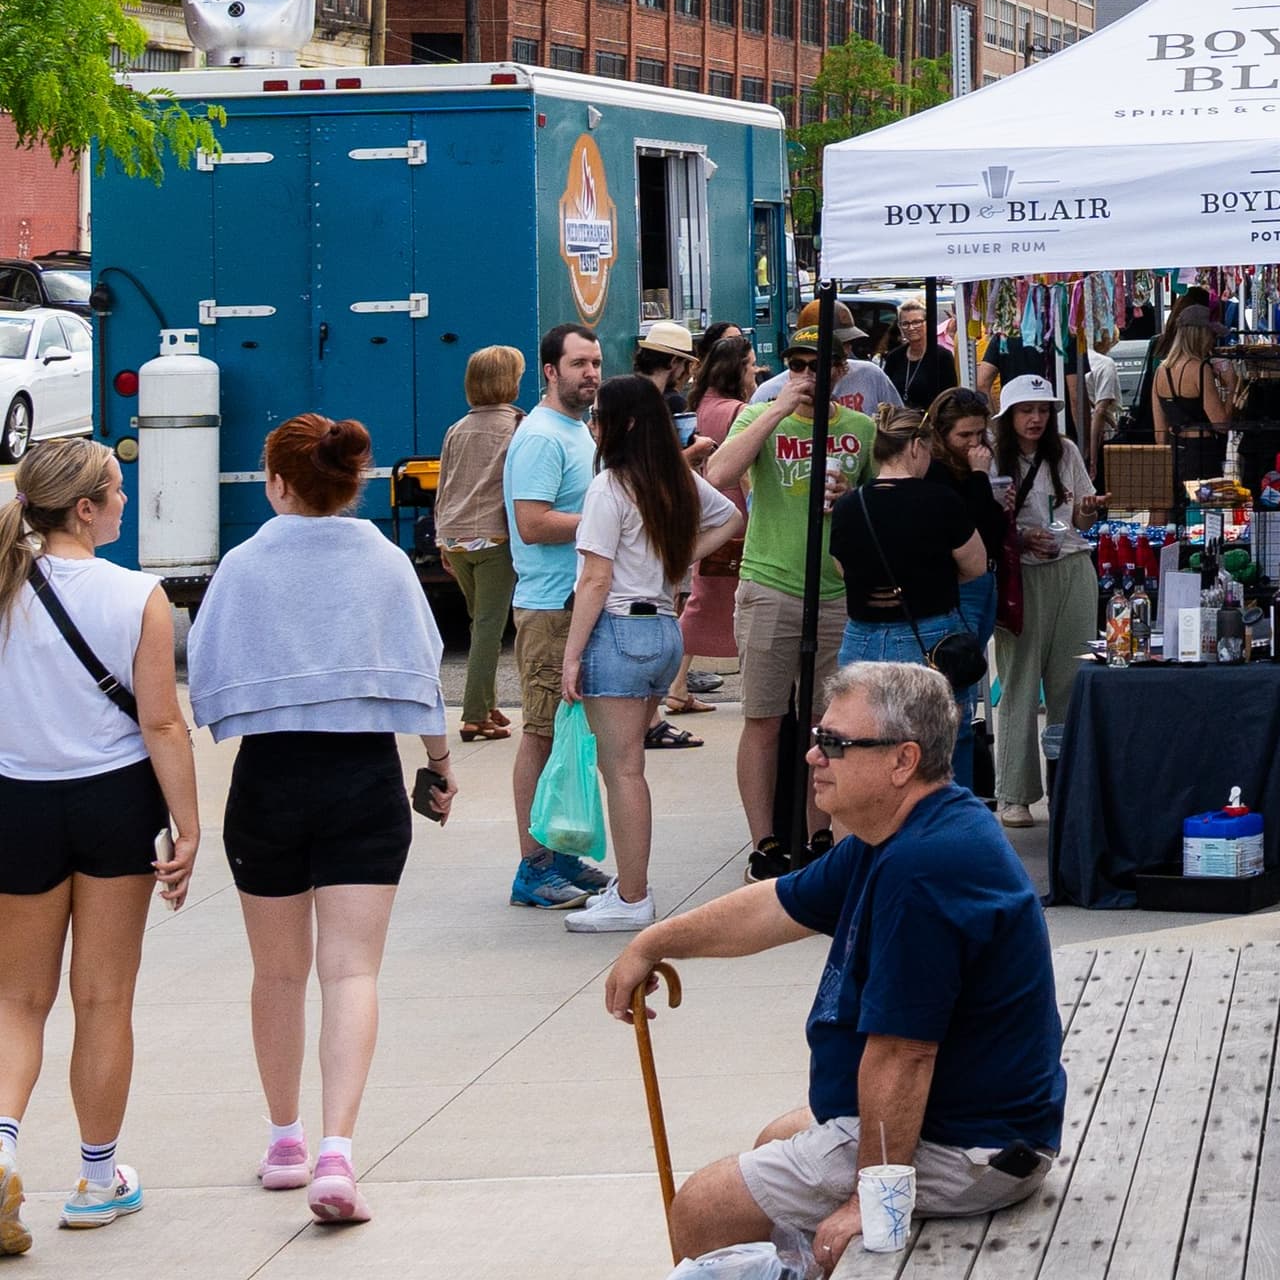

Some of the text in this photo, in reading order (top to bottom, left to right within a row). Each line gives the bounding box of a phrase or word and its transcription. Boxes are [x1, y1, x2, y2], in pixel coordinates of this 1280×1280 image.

[1114, 107, 1220, 118] SPIRITS
[1234, 106, 1248, 114] &
[884, 197, 1111, 226] BOYD & BLAIR
[947, 241, 1046, 255] SILVER RUM
[775, 433, 862, 460] MELO
